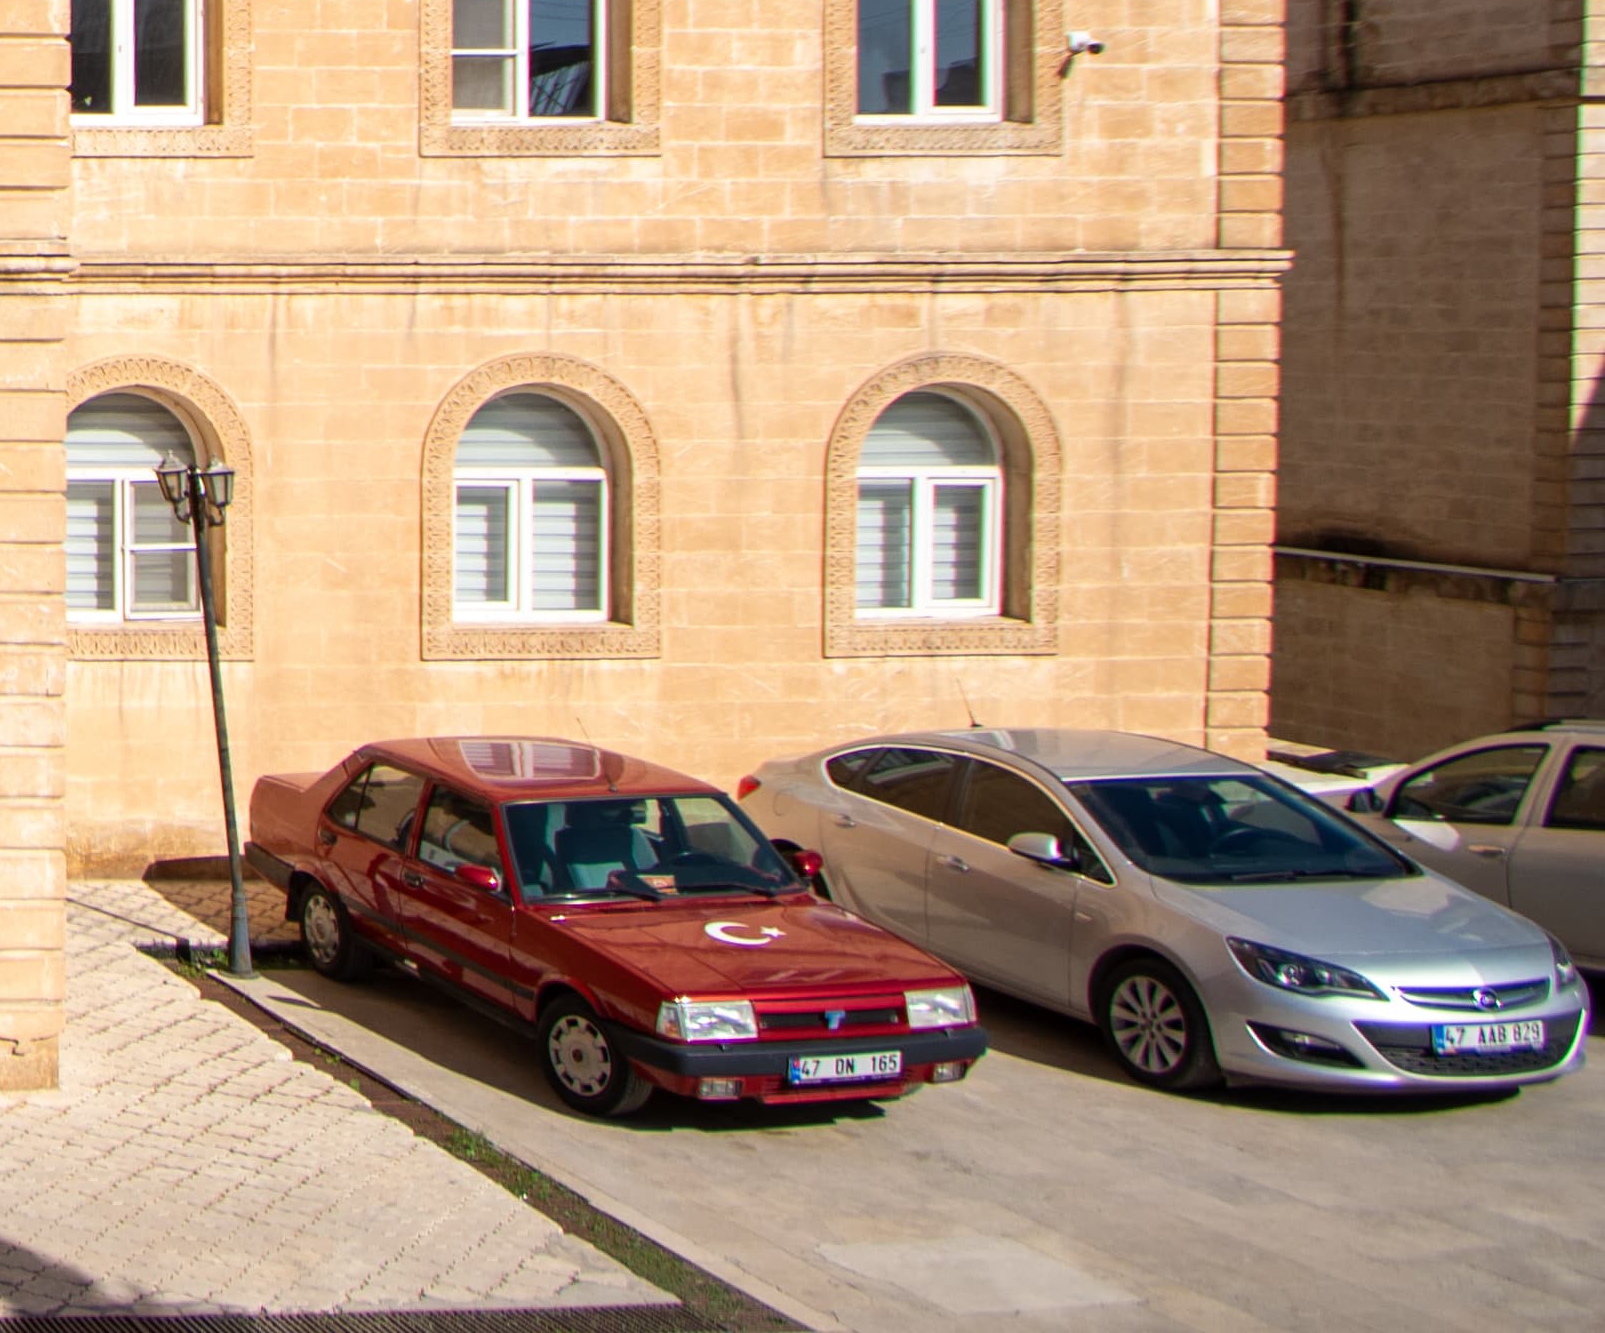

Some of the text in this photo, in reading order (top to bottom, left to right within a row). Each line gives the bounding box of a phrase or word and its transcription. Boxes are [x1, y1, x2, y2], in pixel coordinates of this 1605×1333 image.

[1445, 1026, 1465, 1045] 47
[801, 1058, 820, 1077] 47
[871, 1054, 898, 1072] 165
